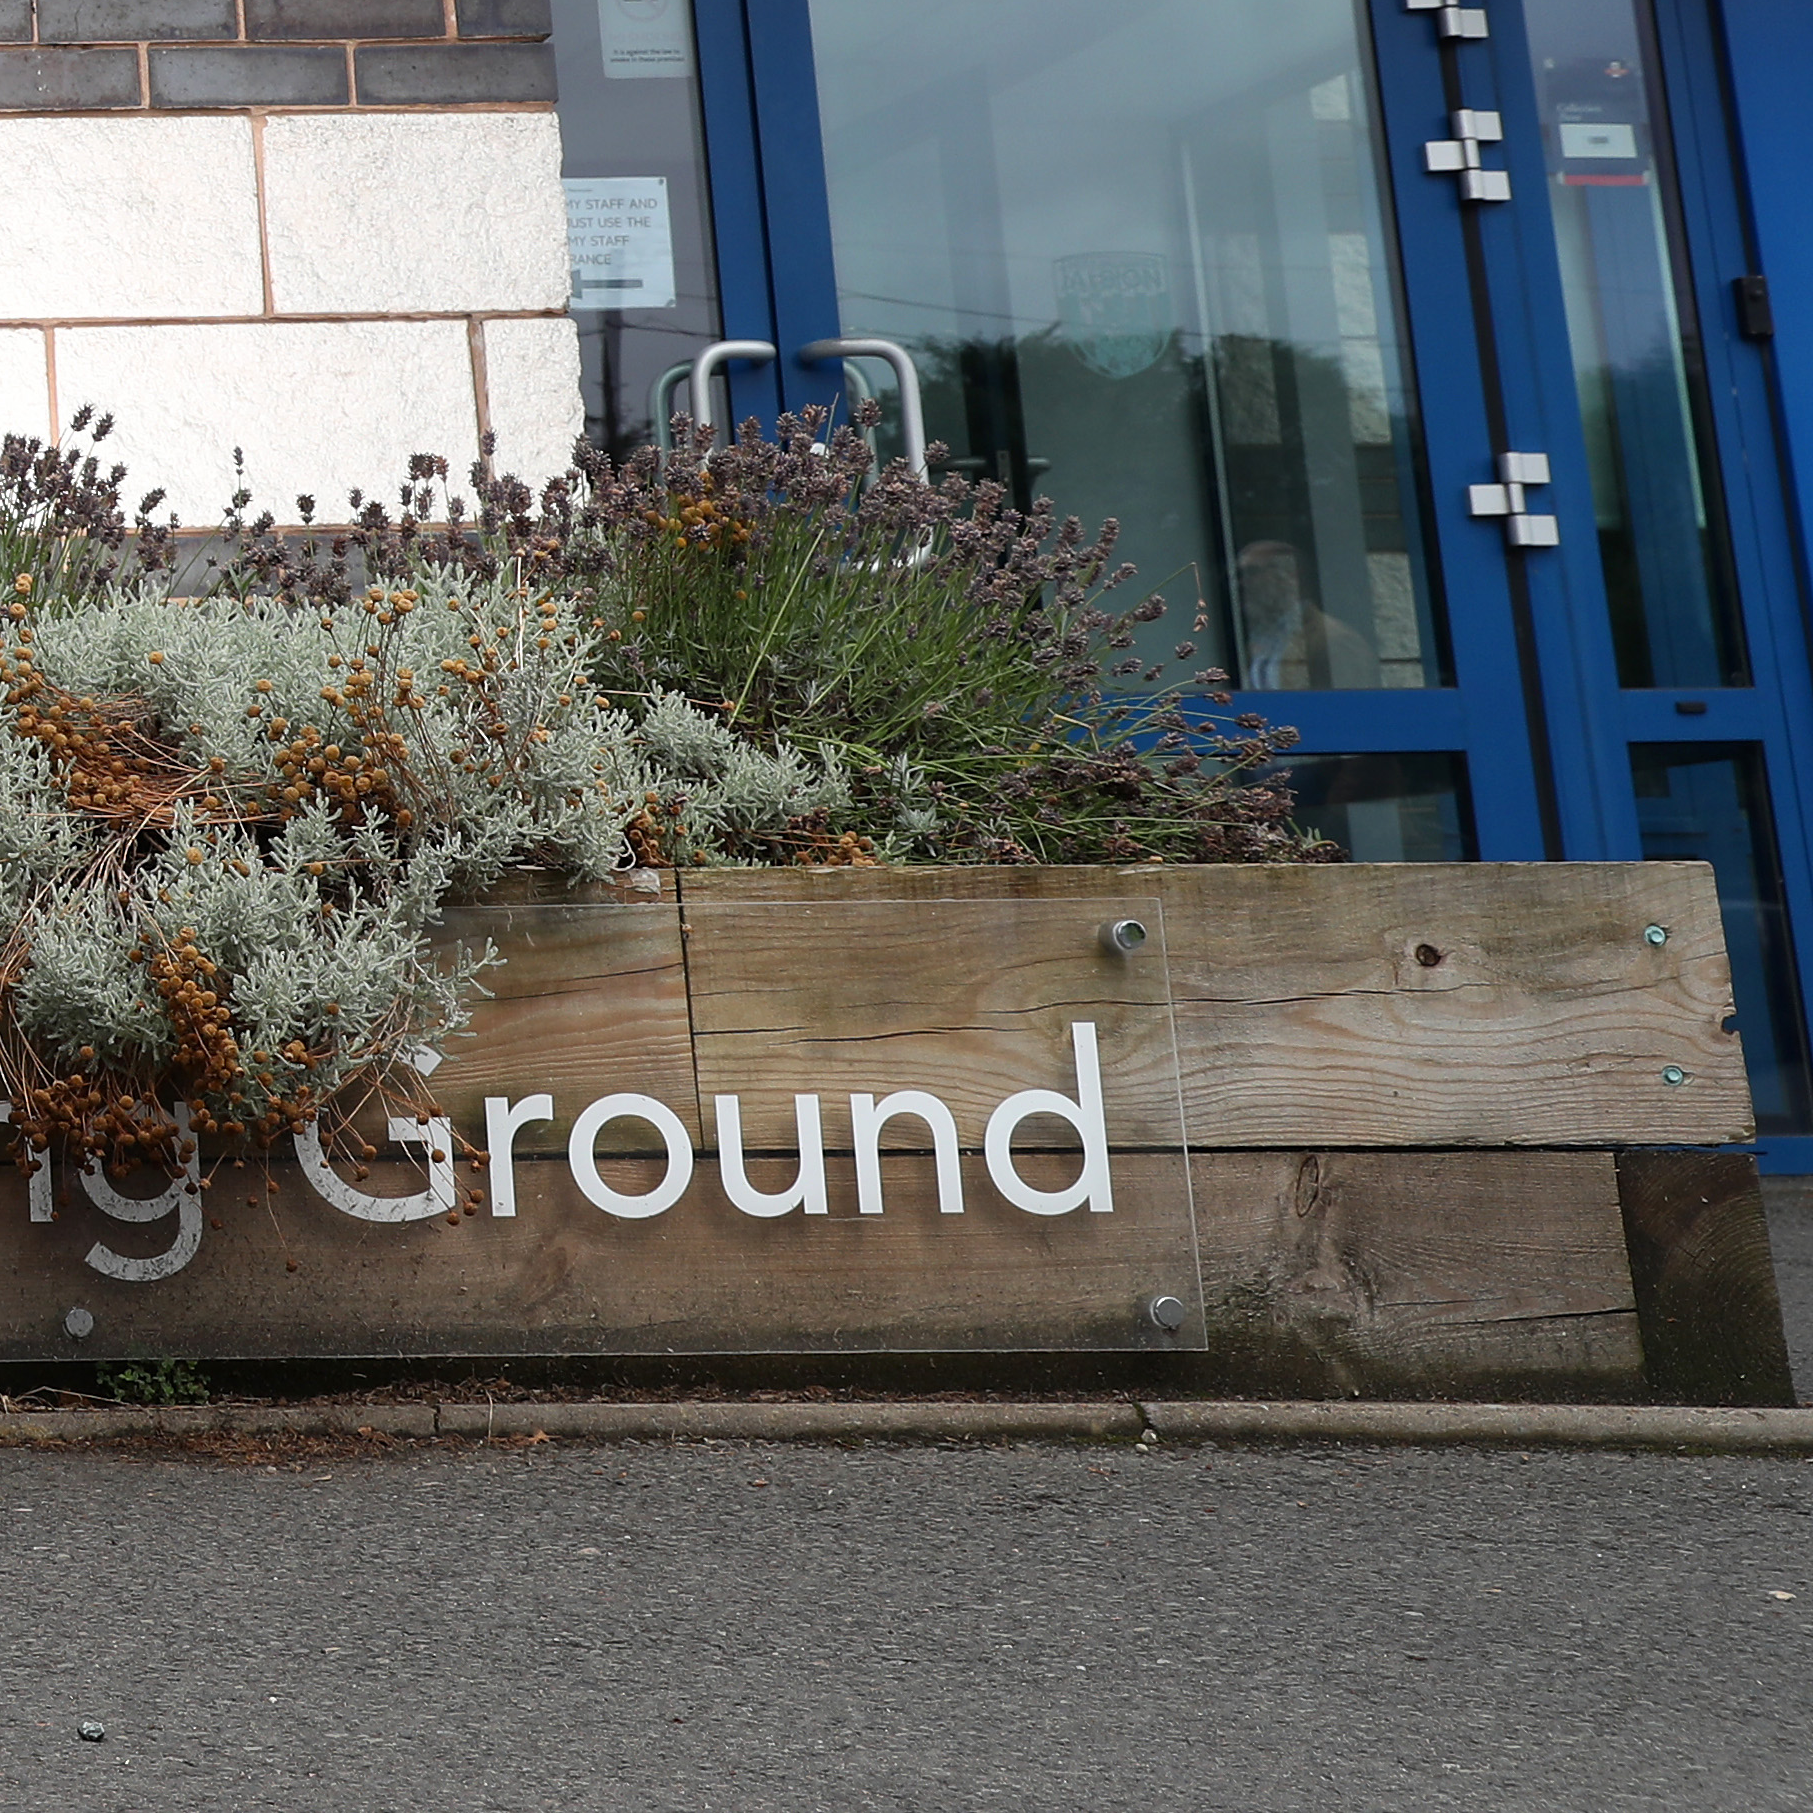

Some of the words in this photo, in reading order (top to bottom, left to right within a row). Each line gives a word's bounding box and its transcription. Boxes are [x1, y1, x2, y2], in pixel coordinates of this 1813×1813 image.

[586, 198, 625, 210] STAFF
[629, 197, 658, 209] AND
[568, 217, 594, 229] UST
[597, 217, 622, 229] USE
[627, 216, 652, 228] THE
[590, 235, 630, 247] STAFF
[569, 253, 612, 266] RANCE
